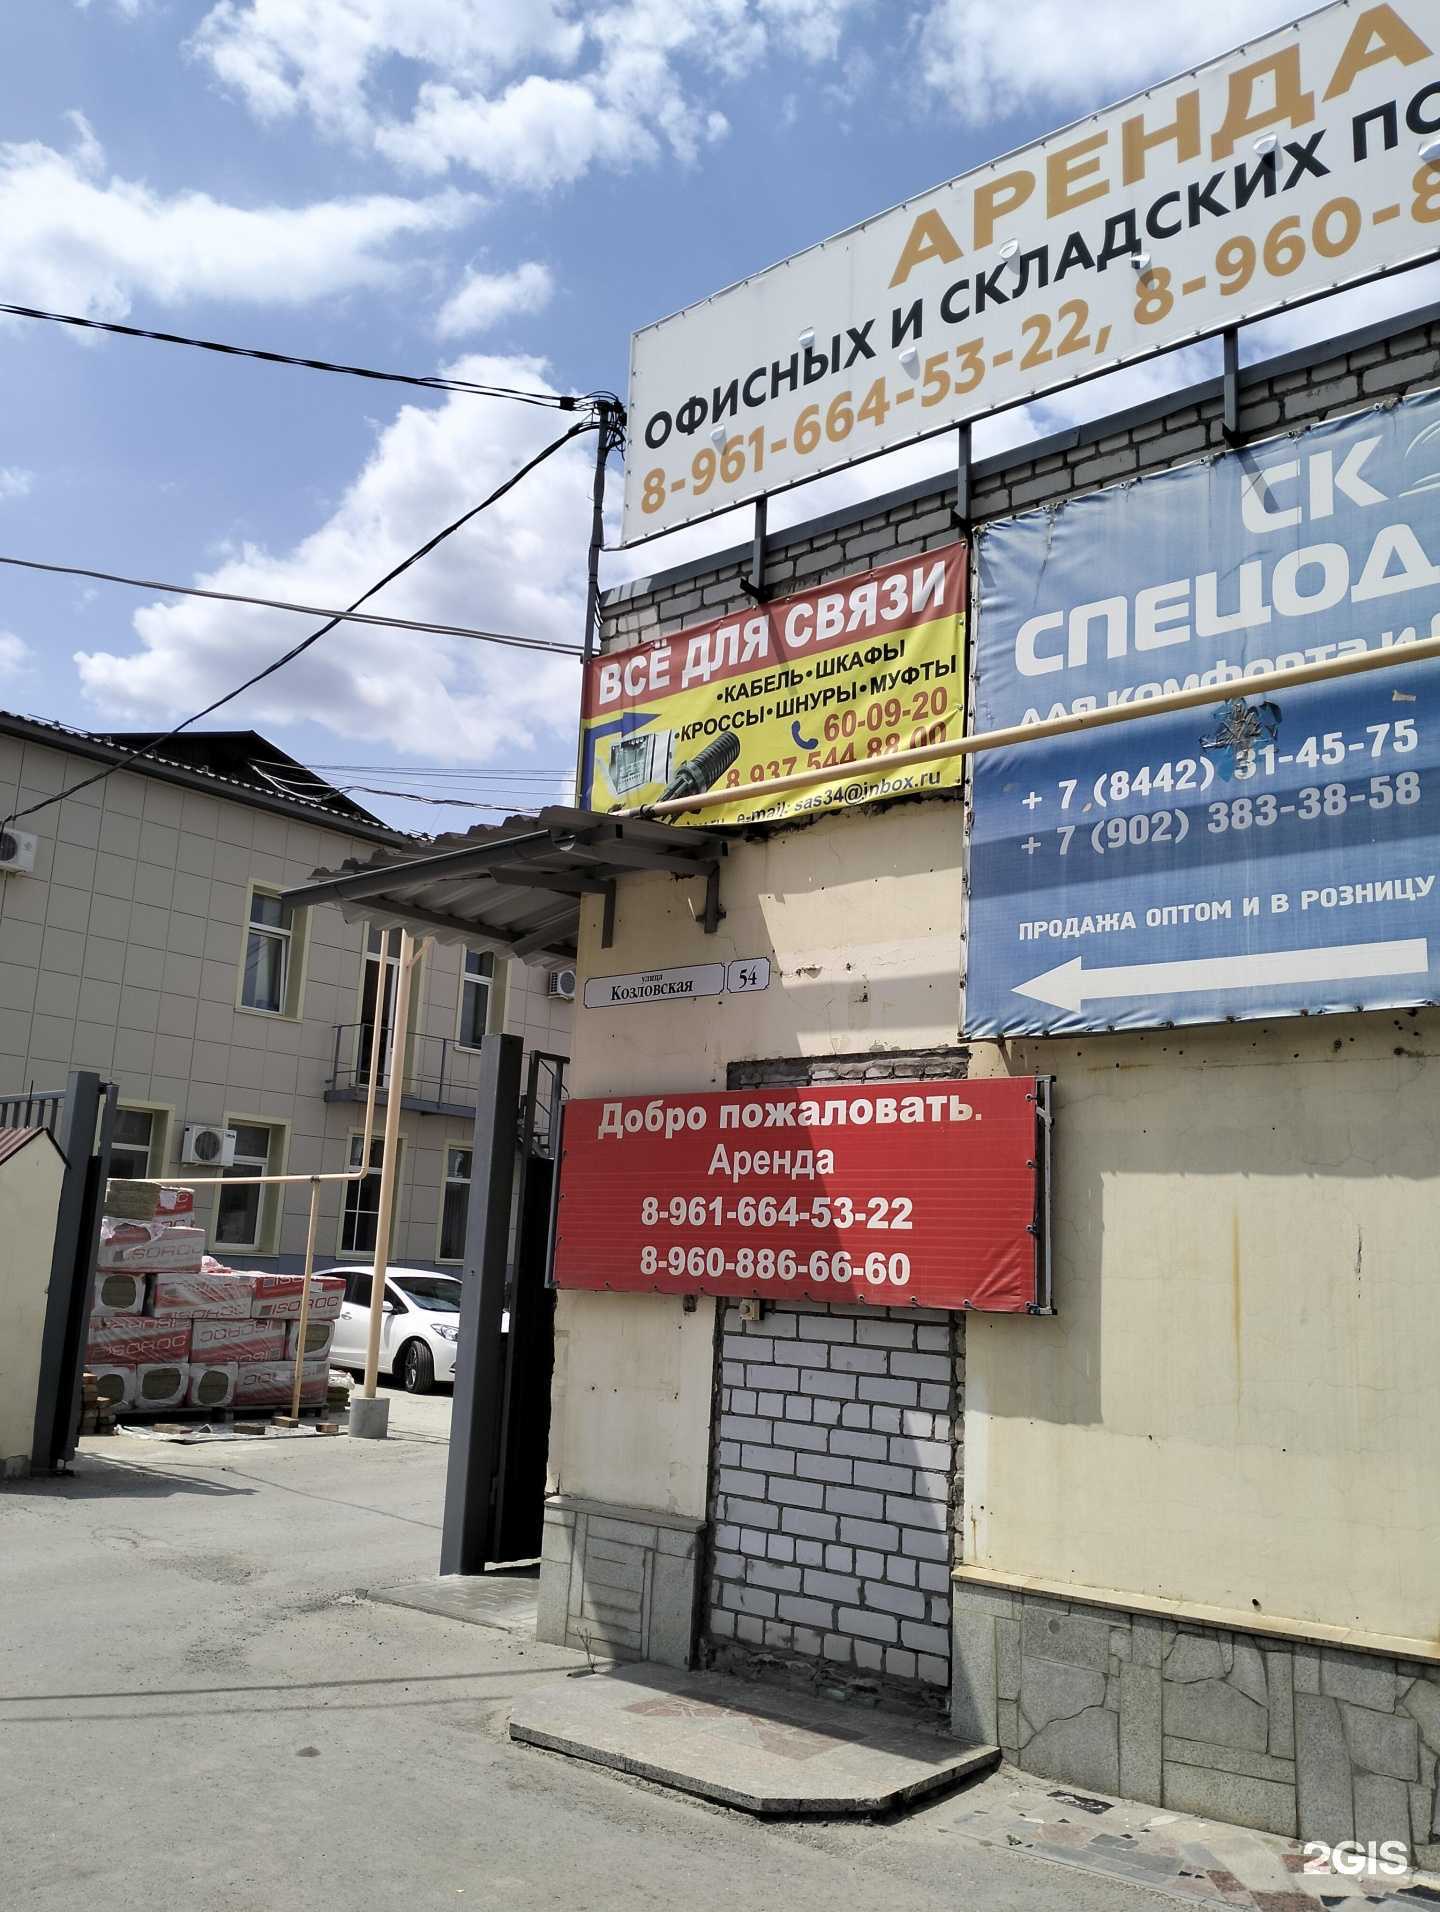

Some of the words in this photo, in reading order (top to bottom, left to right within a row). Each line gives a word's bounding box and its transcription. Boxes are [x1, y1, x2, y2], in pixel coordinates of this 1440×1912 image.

[888, 2, 1434, 289] АРЕНДА
[645, 319, 876, 449] ОФИСНЫХ
[892, 298, 922, 348] И
[940, 129, 1331, 324] СКЛАДСКИХ
[1240, 434, 1389, 534] СК
[599, 640, 671, 704] ВСЁ
[681, 615, 769, 688] ДЛЯ
[784, 560, 946, 648] СВЯЗИ
[815, 640, 905, 679] ШКАФЫ
[776, 682, 857, 719] ШНУРЫ
[871, 655, 957, 696] МУФТЫ
[824, 687, 948, 742] 60-09-20
[1058, 780, 1077, 809] 7
[1094, 756, 1215, 807] (8442)
[1233, 719, 1418, 779] 31-45-75
[794, 770, 941, 812] sas34@inbox.ru
[1057, 824, 1075, 855] 7
[1091, 808, 1189, 854] (902)
[1207, 772, 1421, 834] 383-38-58
[1019, 911, 1136, 940] ПРОДАЖА
[1146, 900, 1231, 927] ОПТОМ
[1243, 897, 1260, 916] И
[1271, 893, 1289, 913] В
[1301, 875, 1435, 911] РОЗНИЦУ
[611, 979, 694, 1001] Козловская
[641, 973, 663, 984] улица
[738, 965, 757, 988] 54
[598, 1100, 707, 1139] Добро
[719, 1094, 982, 1129] пожаловать.
[708, 1143, 834, 1183] Аренда
[641, 1196, 914, 1230] 8-961-664-53-22
[640, 1246, 910, 1286] 8-960-886-66-60
